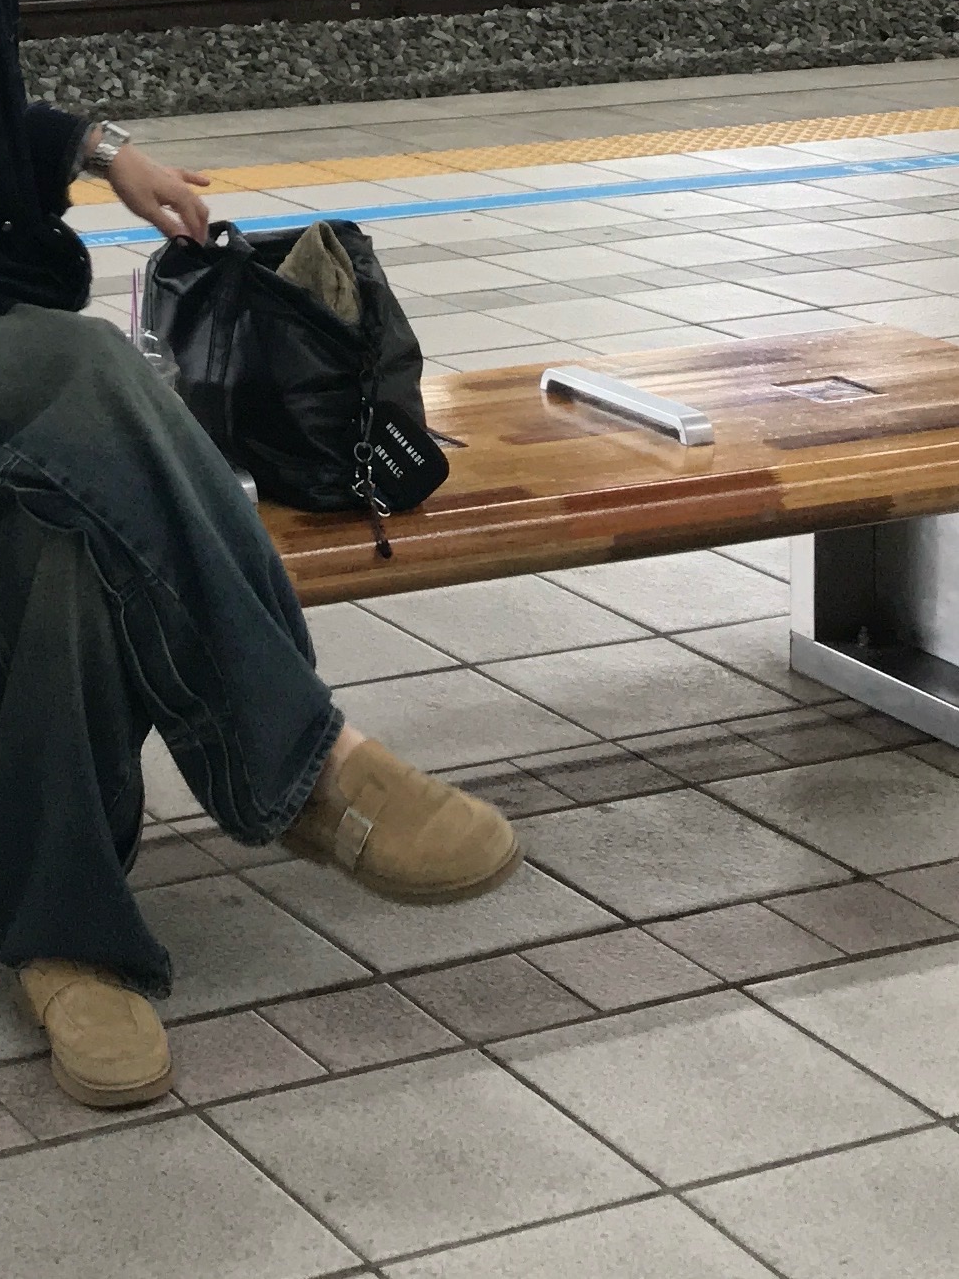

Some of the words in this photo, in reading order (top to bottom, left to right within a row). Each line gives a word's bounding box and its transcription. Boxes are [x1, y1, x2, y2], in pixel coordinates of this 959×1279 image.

[385, 421, 409, 448] HUMAN
[405, 445, 426, 467] MADE
[385, 458, 404, 479] ALLS
